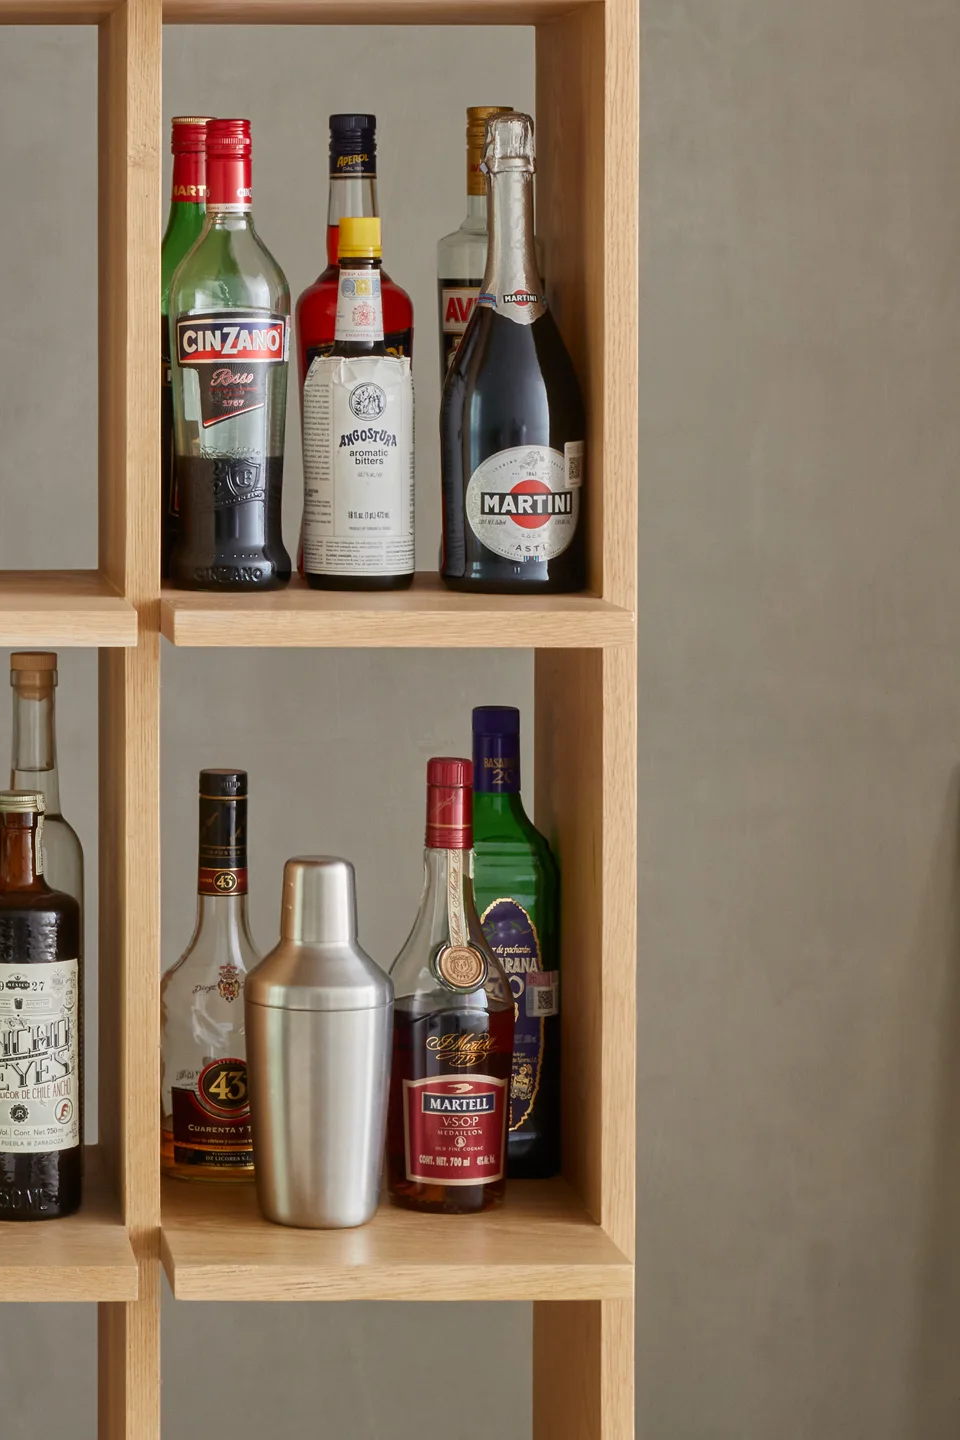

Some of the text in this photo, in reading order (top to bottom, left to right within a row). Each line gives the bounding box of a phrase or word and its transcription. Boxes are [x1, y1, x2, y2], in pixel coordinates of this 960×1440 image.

[504, 294, 538, 302] MARTINI
[182, 326, 280, 355] CINZANO
[210, 368, 254, 386] Rosso
[339, 428, 397, 448] ANGOSTURA
[350, 448, 389, 457] aromatic
[355, 457, 384, 465] bitters
[484, 494, 570, 514] MARTINI
[515, 544, 546, 552] ASTI
[208, 1070, 245, 1100] 43
[430, 1098, 490, 1111] MARTELL
[188, 1124, 236, 1134] CUARENTA
